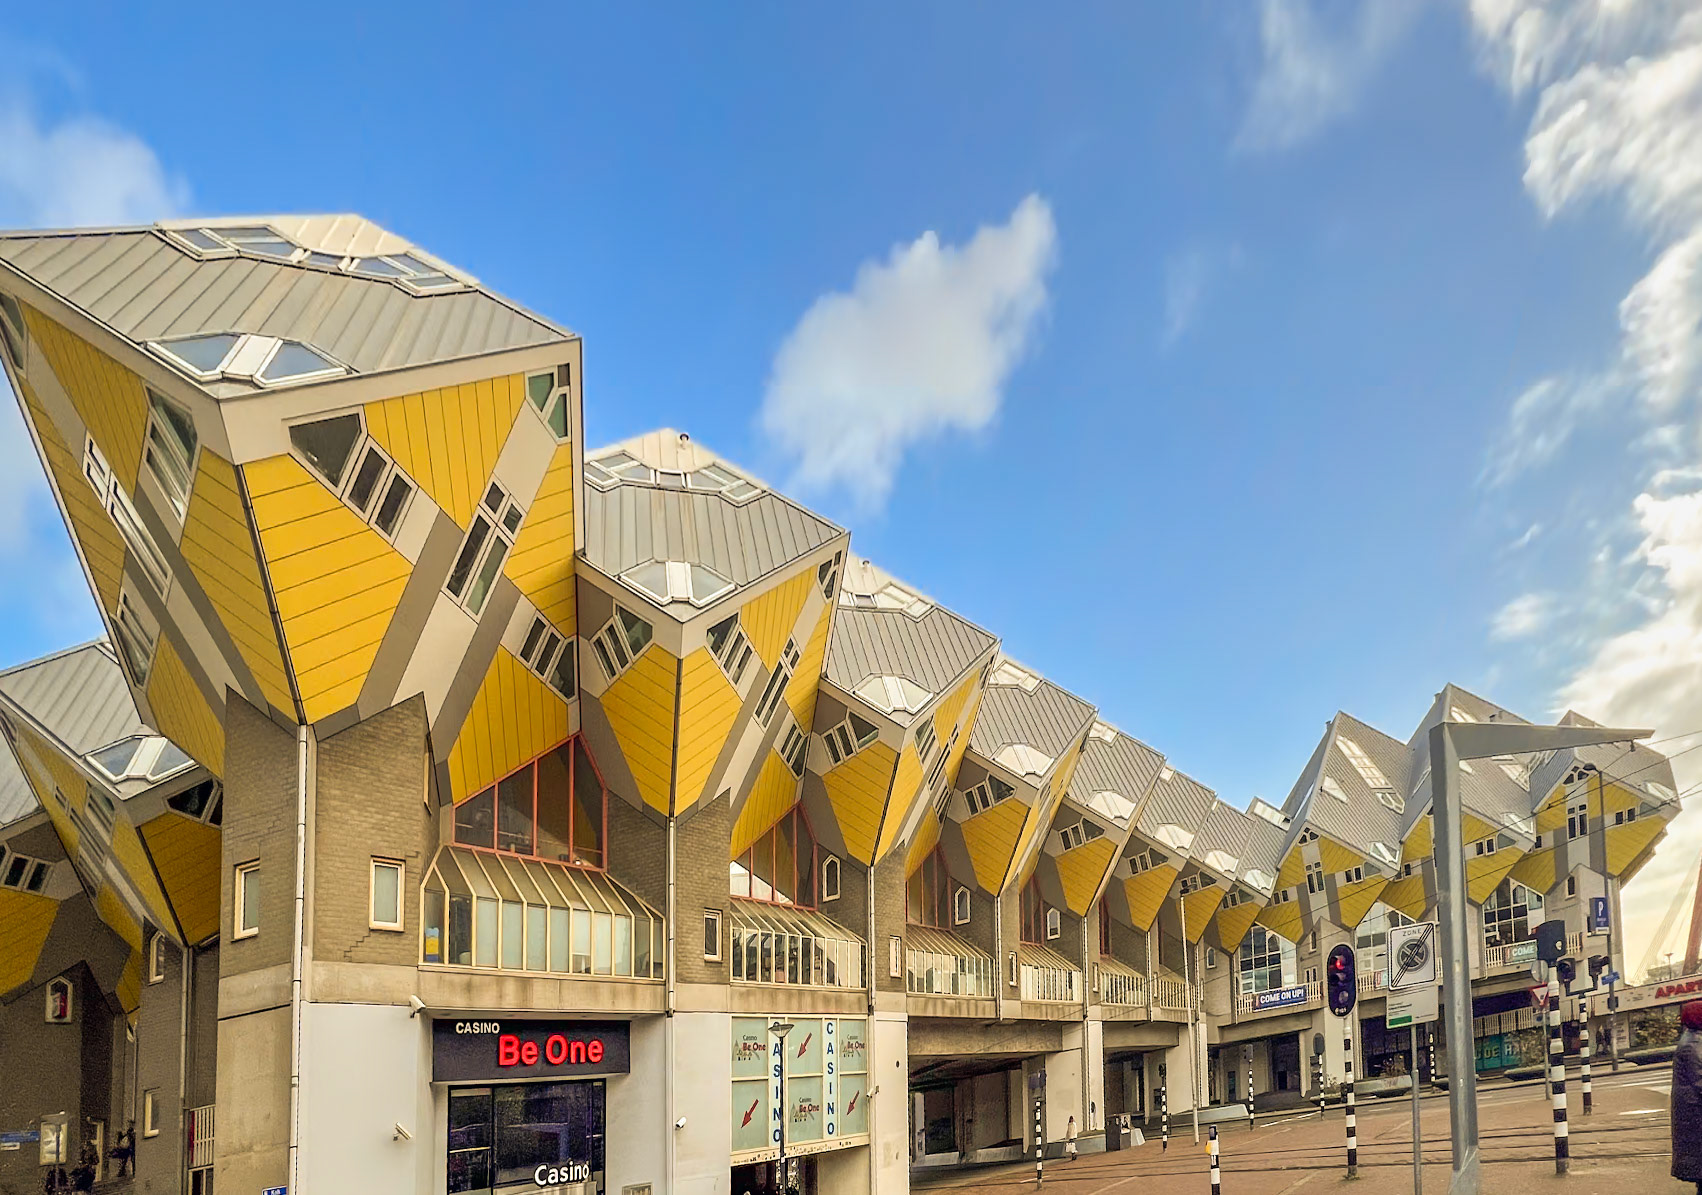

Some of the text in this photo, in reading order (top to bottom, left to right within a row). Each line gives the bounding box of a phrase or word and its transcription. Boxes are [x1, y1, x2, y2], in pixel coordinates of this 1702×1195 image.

[1598, 901, 1604, 917] P
[1402, 928, 1422, 937] ZONE
[1512, 946, 1535, 957] COME
[1260, 988, 1304, 1004] COME ON UP!
[455, 1022, 501, 1035] CASINO
[498, 1034, 604, 1067] Be One
[742, 1042, 766, 1051] Be One
[826, 1022, 835, 1135] CASINO
[772, 1042, 782, 1143] ASINO
[808, 1103, 820, 1112] One
[534, 1159, 590, 1186] Casino
